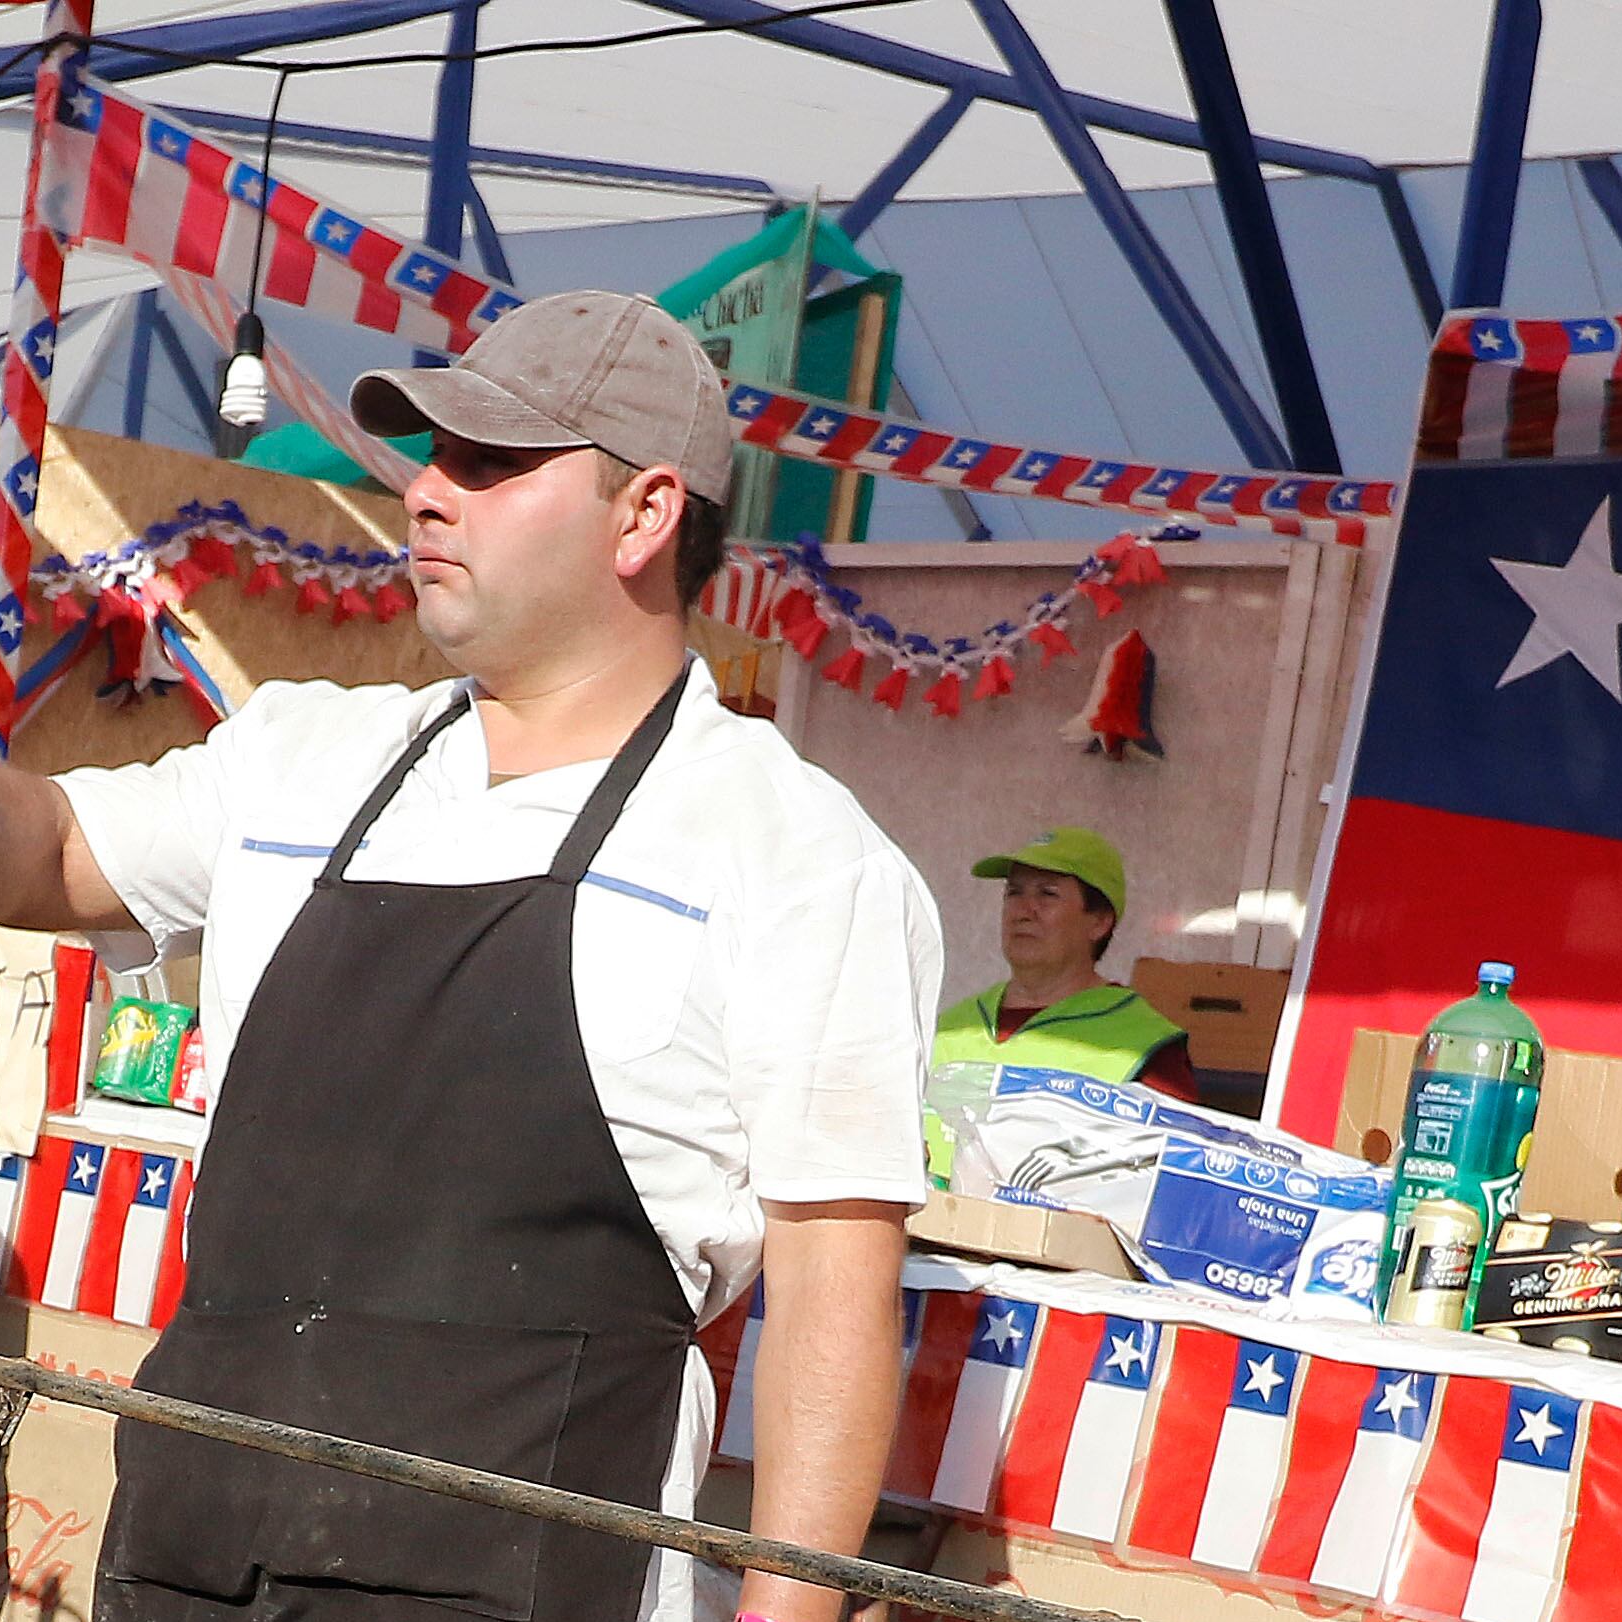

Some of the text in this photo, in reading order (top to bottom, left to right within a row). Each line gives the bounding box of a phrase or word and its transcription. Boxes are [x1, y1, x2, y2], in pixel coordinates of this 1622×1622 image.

[1237, 1195, 1308, 1228] Una Hoja
[1205, 1261, 1285, 1299] 28650
[1545, 1262, 1621, 1298] Miller
[1513, 1296, 1584, 1315] GENUINE
